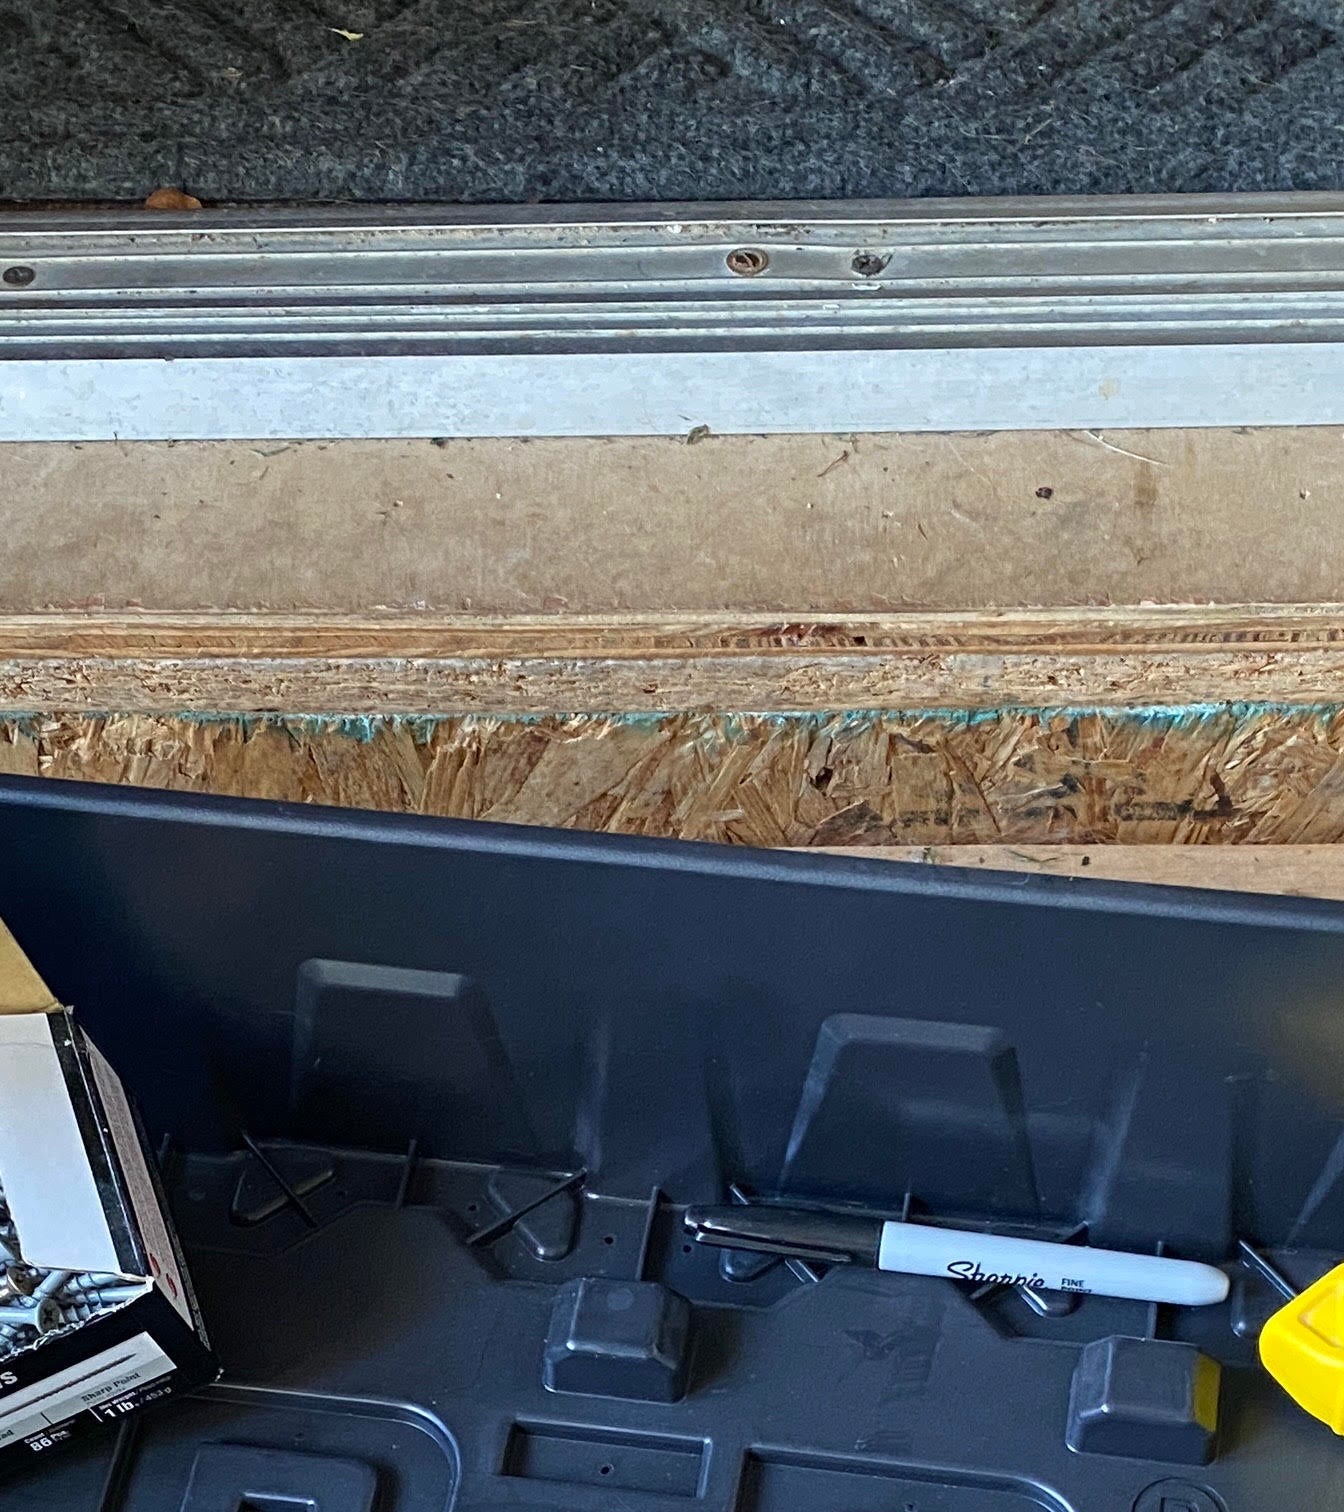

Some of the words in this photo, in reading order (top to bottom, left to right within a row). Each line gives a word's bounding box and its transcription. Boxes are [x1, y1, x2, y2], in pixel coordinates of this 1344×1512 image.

[1061, 1277, 1084, 1287] FINE
[115, 1399, 140, 1413] lb.
[29, 1436, 52, 1452] 86
